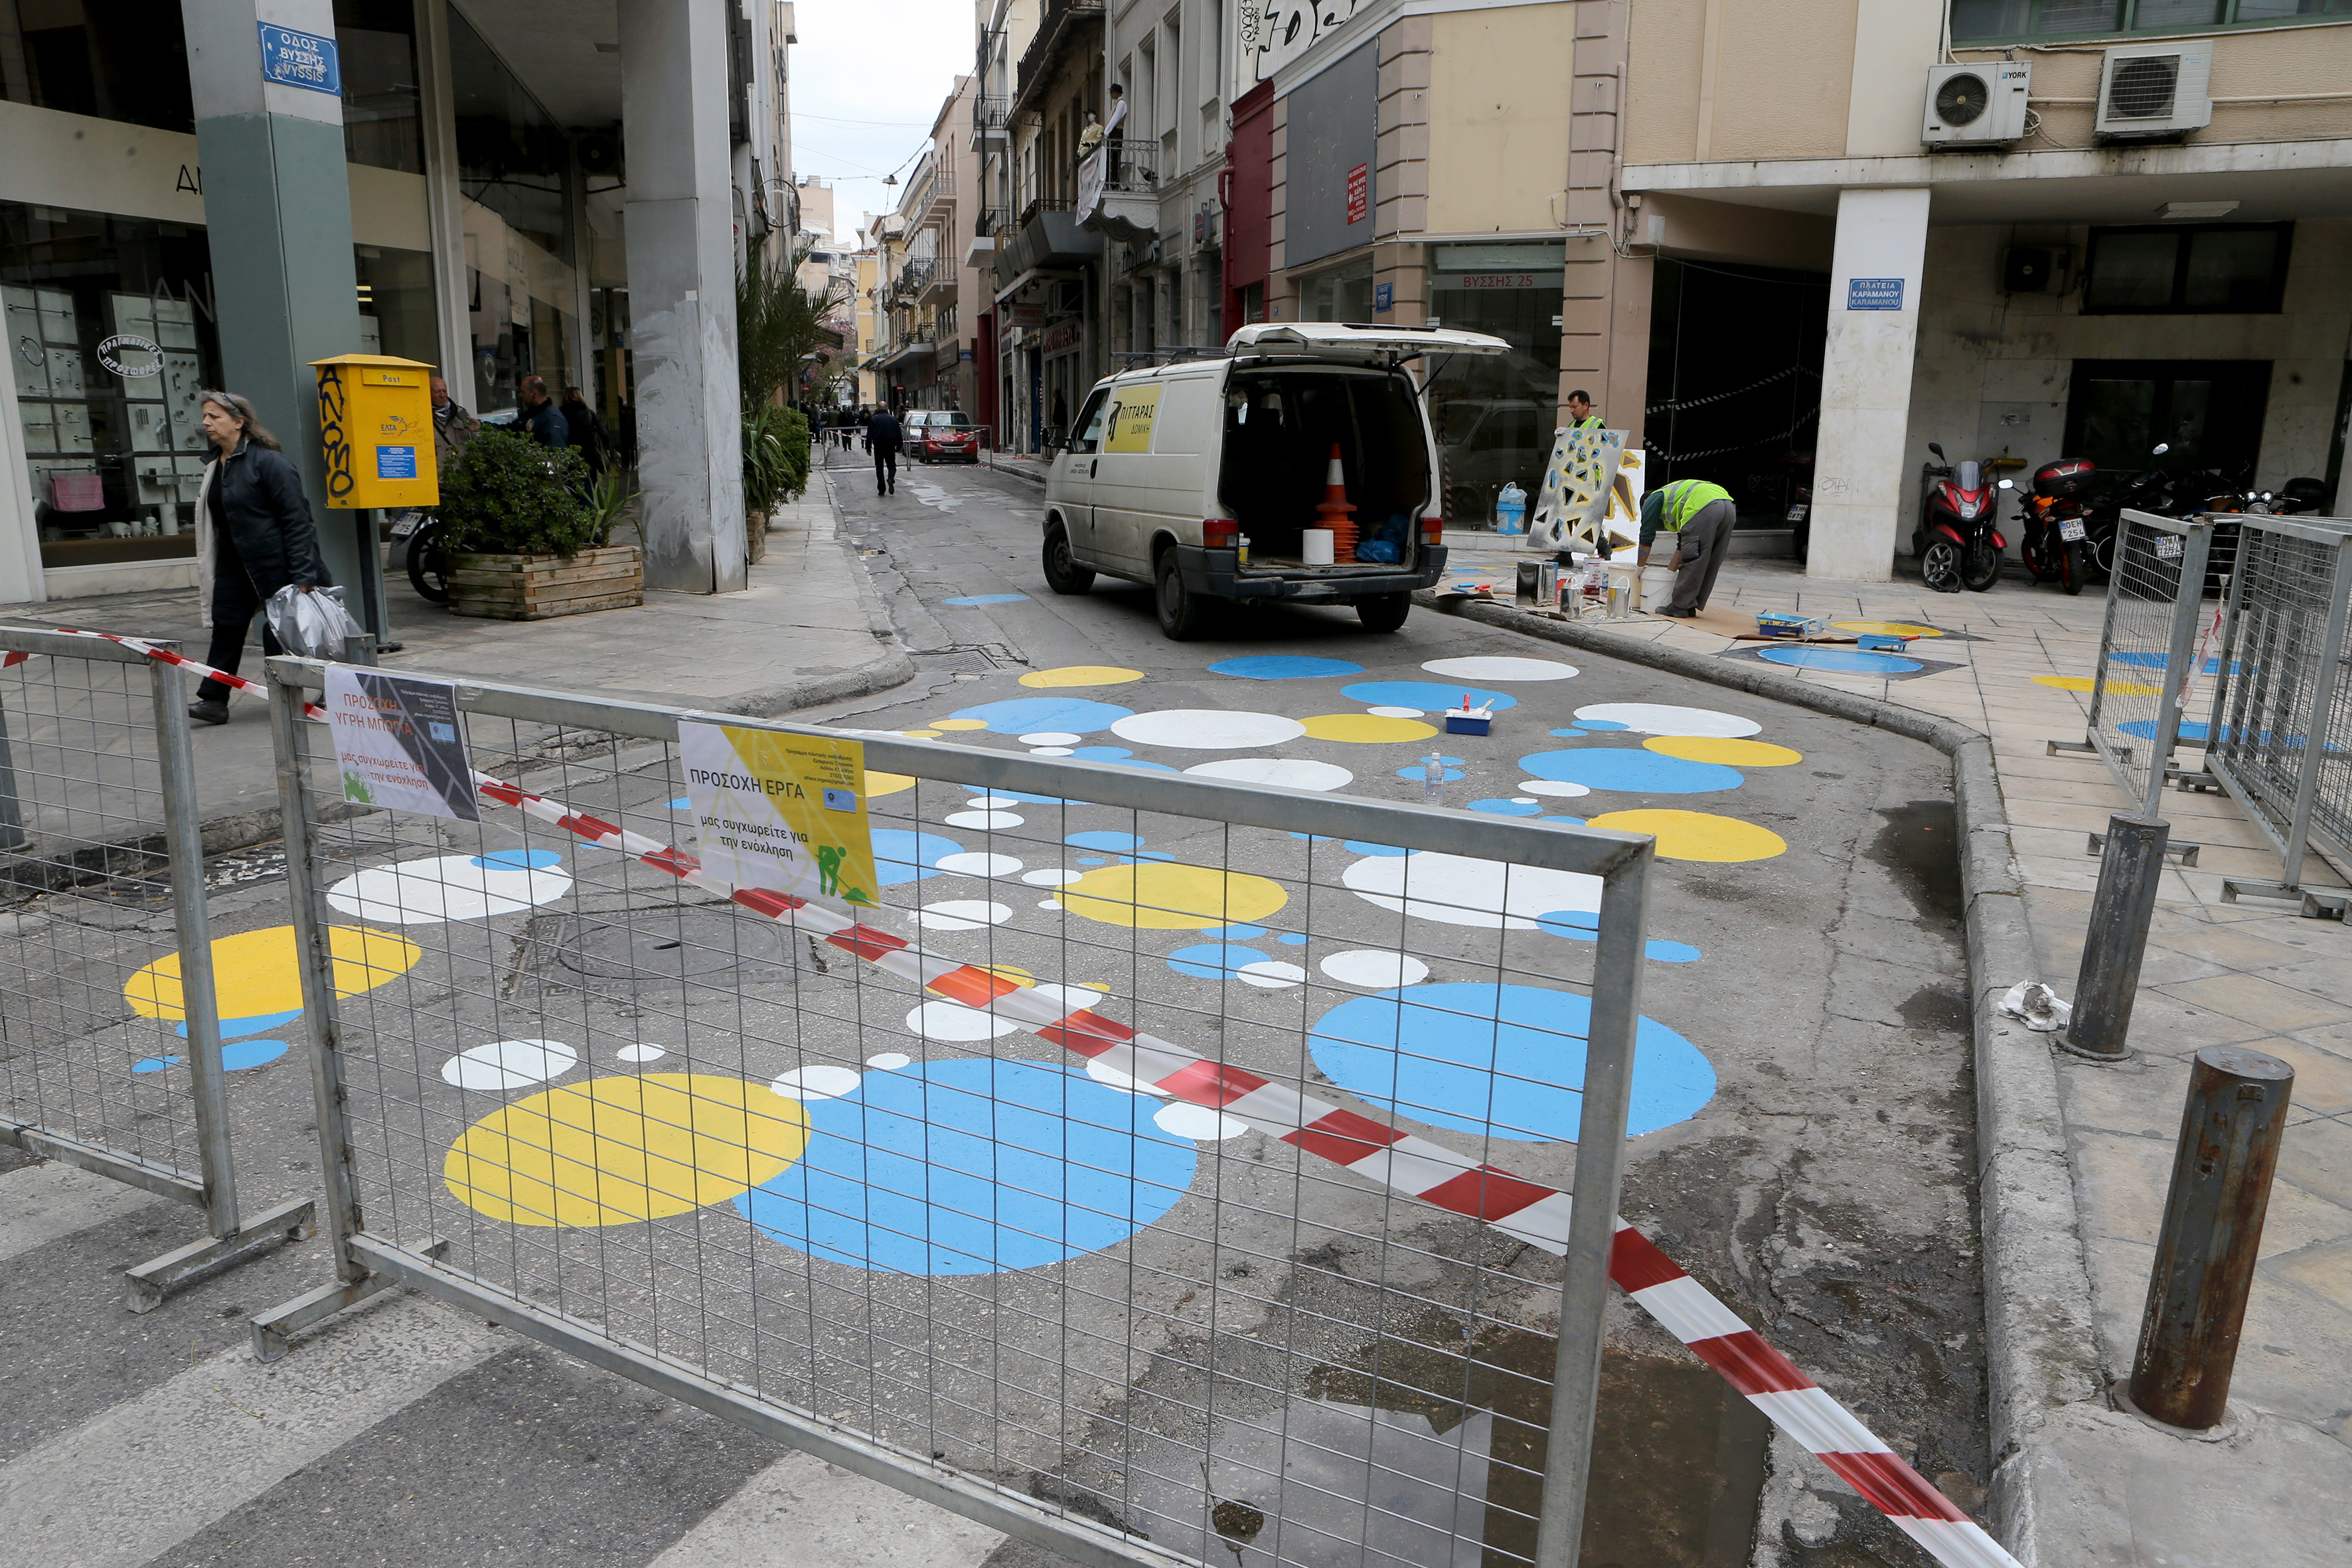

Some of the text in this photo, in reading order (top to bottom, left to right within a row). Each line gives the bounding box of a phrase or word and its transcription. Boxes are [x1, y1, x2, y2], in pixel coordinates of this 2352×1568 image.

[281, 33, 319, 52] ΟΔΟΣ
[279, 47, 324, 67] ΒΥΣΣΗΣ
[284, 64, 324, 83] VYSSIS
[1463, 275, 1533, 287] ΒΥΣΣΗΣ 25
[100, 337, 161, 356] ΠΡΑΓΜΑΤΙΚΕΣ
[102, 356, 161, 375] ΠΡΟΣΦΟΡΕΣ
[1120, 404, 1154, 420] ΠΙΤΤΑΡΑΣ
[1131, 424, 1150, 435] ΔΟΜΙΚΗ
[343, 693, 398, 714] ΠΡΟΣΟΧΗ
[335, 712, 414, 736] ΥΓΡΗ ΜΠΟΓΙΑ
[341, 752, 425, 773] μας συγχωρείτε για
[369, 771, 430, 791] την ενόχληση
[690, 768, 805, 799] ΠΡΟΣΟΧΗ ΕΡΓΑ
[700, 815, 809, 844] μας συγχωρείτε για
[720, 835, 793, 861] την ενόχληση
